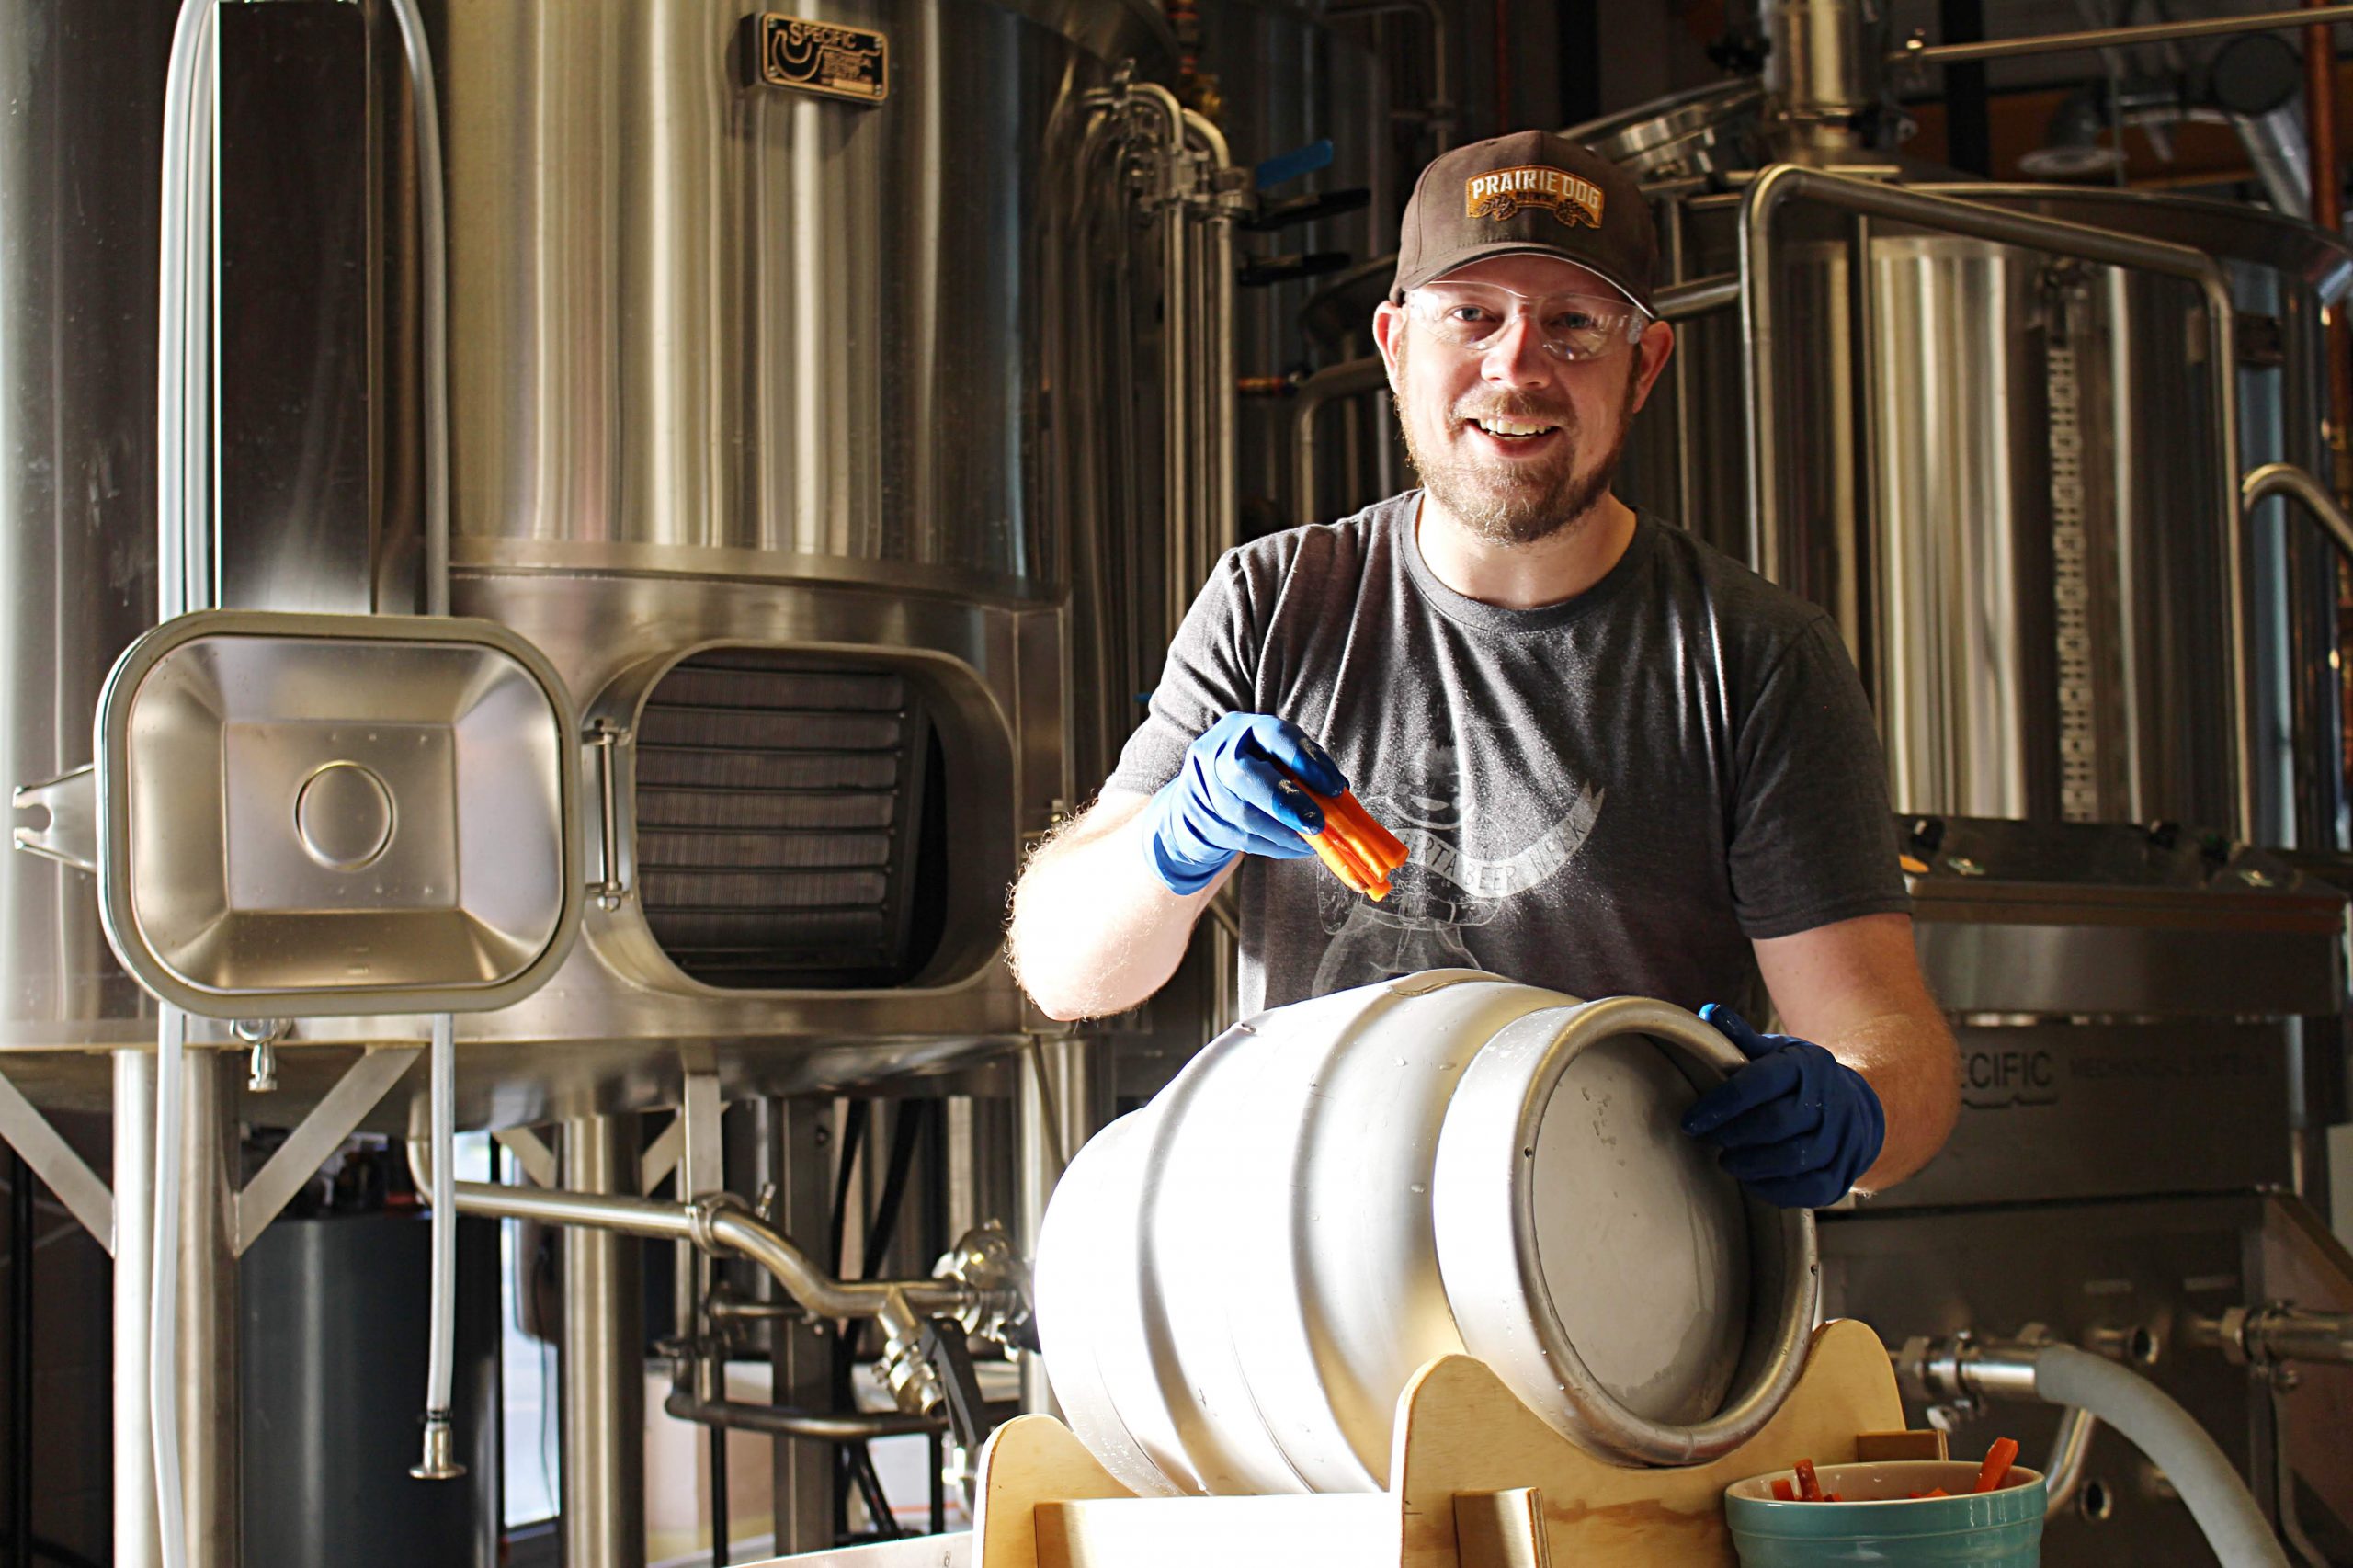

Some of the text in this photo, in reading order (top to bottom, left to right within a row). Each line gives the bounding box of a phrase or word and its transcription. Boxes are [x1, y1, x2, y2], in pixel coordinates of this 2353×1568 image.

[789, 22, 857, 49] SPECIFIC
[1472, 170, 1601, 209] PRAIRIE DOG
[1466, 865, 1517, 892] BEER
